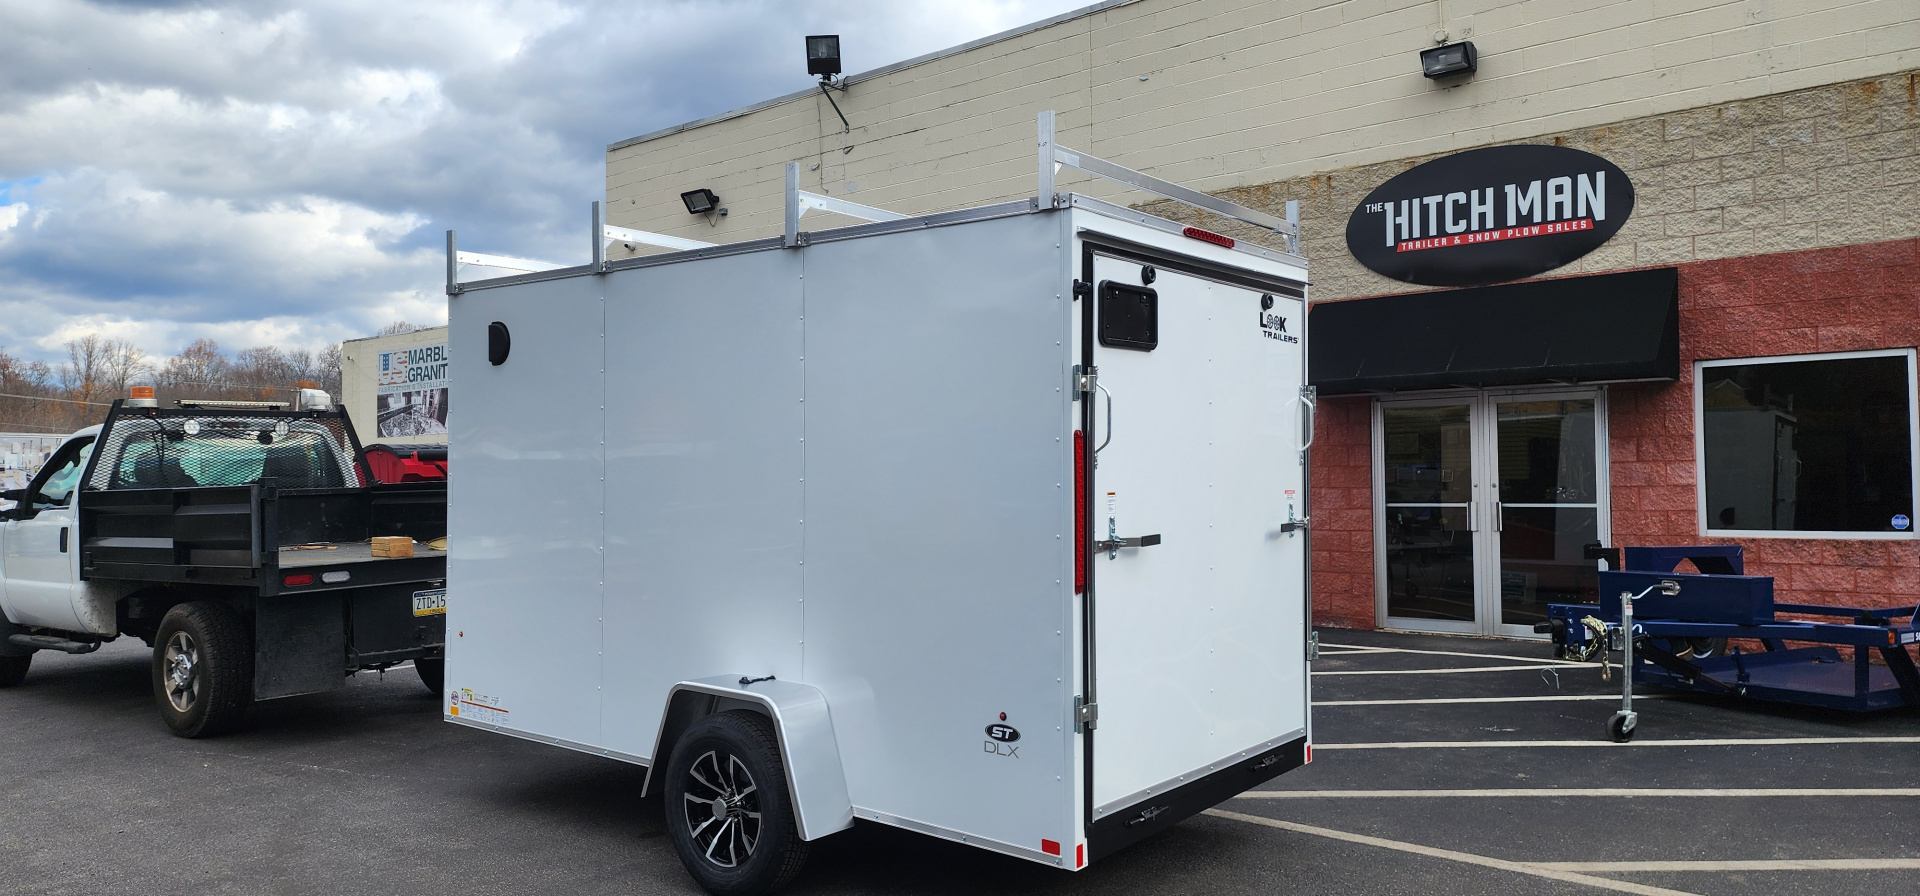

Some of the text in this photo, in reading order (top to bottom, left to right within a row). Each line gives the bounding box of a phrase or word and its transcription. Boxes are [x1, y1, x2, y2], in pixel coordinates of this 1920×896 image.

[1365, 202, 1384, 214] THE
[1384, 171, 1605, 247] HITCH MAN
[1401, 220, 1587, 251] TRAILER & SNOW PLOW SALES
[1262, 330, 1299, 344] TRAILERS
[992, 726, 1013, 739] ST
[984, 740, 1019, 759] DLX
